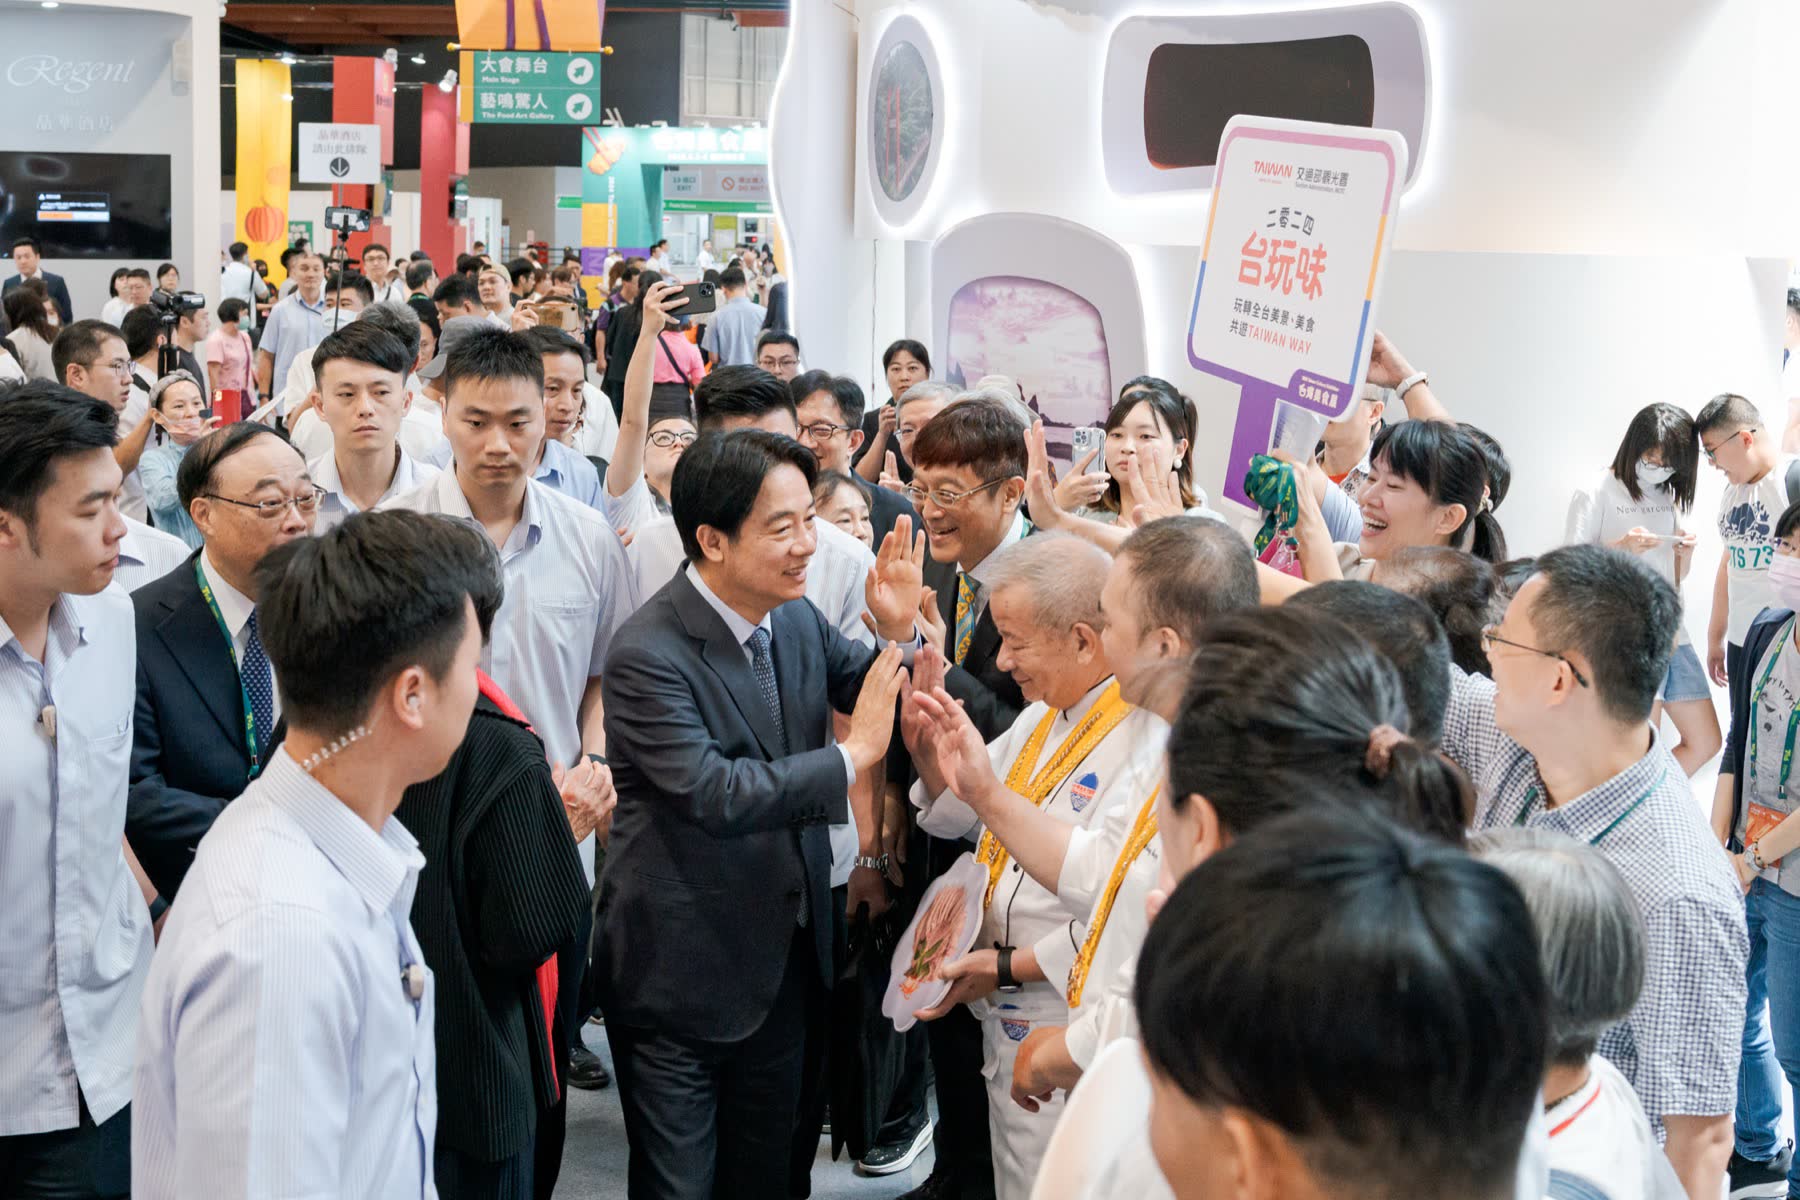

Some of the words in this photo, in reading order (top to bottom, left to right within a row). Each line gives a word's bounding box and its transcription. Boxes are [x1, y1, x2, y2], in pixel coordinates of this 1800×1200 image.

[480, 55, 548, 73] 大會舞台
[7, 54, 136, 93] Regent
[501, 76, 520, 85] Stage
[480, 92, 548, 110] 藝鳴驚人
[482, 111, 496, 119] The
[497, 111, 514, 119] Food
[529, 112, 555, 120] Gallery
[1254, 160, 1293, 178] TAIWAN
[1266, 206, 1315, 236] 二零二四
[1238, 230, 1327, 301] 台玩味
[1288, 336, 1312, 355] WAY
[1616, 504, 1637, 513] New
